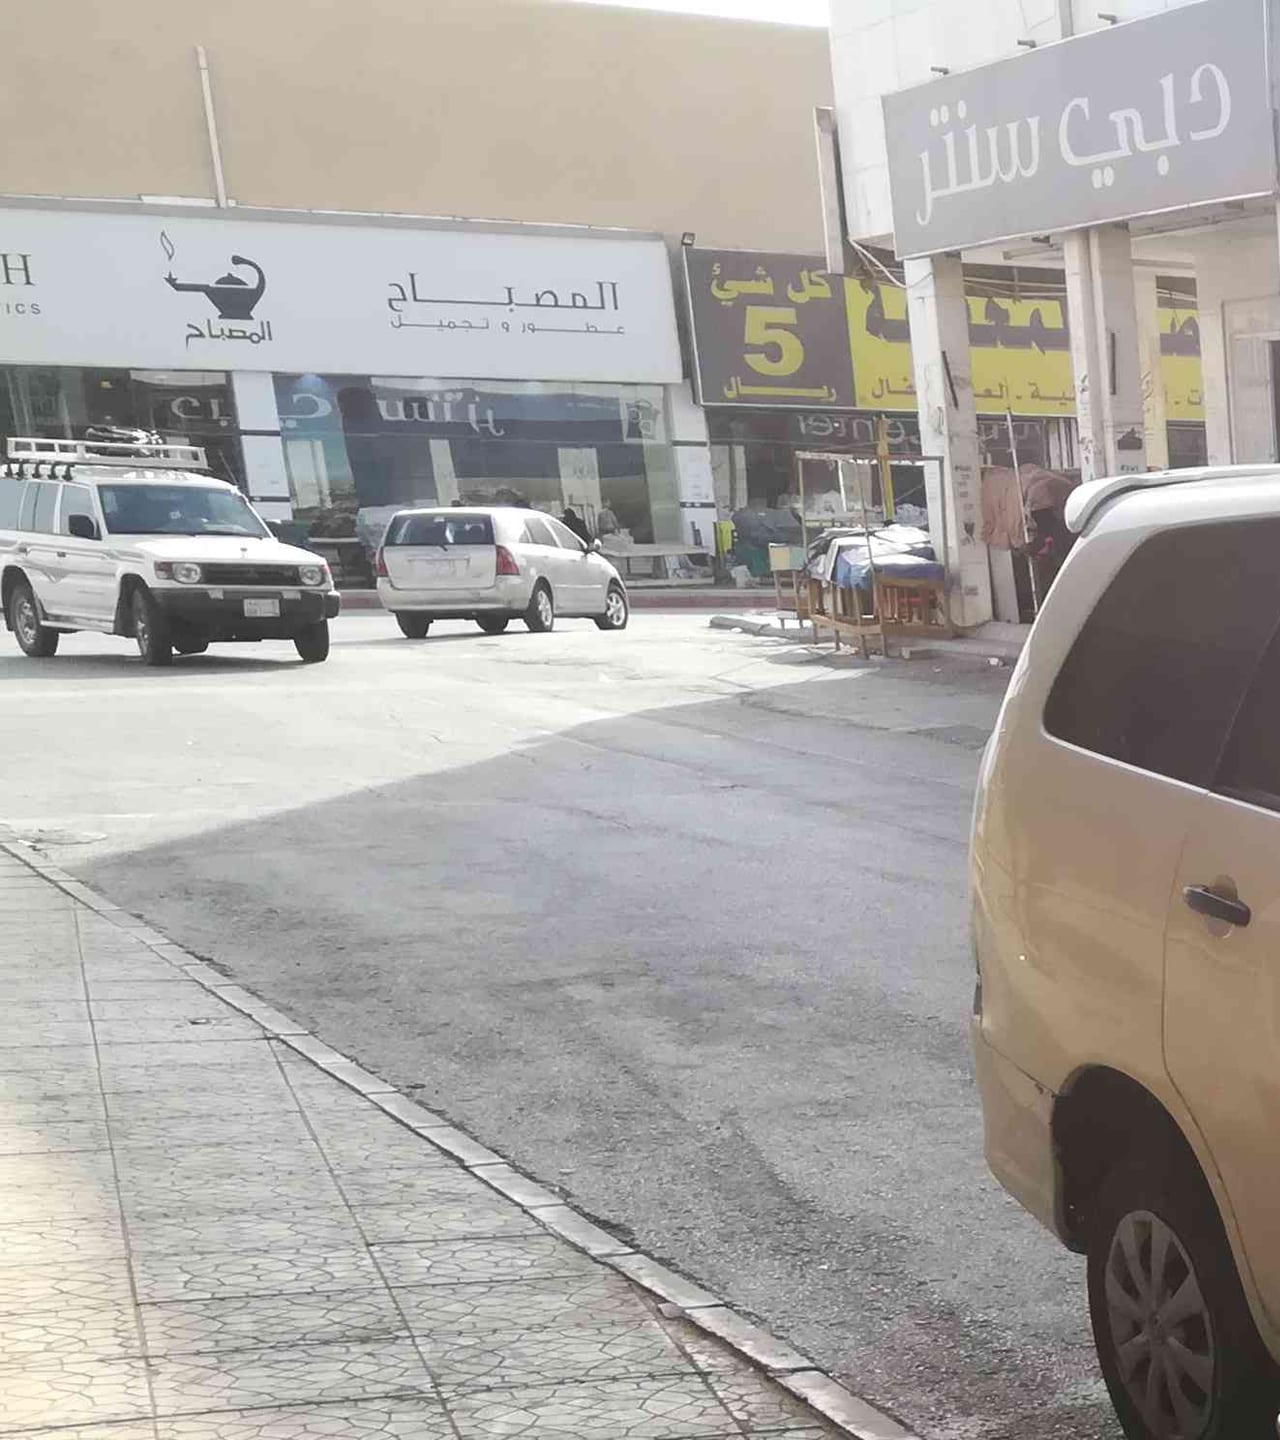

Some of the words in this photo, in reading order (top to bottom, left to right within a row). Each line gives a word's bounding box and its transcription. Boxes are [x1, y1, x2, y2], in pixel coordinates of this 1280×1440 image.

[1059, 64, 1231, 188] دبي
[916, 100, 1040, 225] سنتر
[388, 272, 619, 312] المصباح
[787, 269, 832, 304] كل
[186, 319, 273, 350] المصباح
[743, 305, 804, 376] 5
